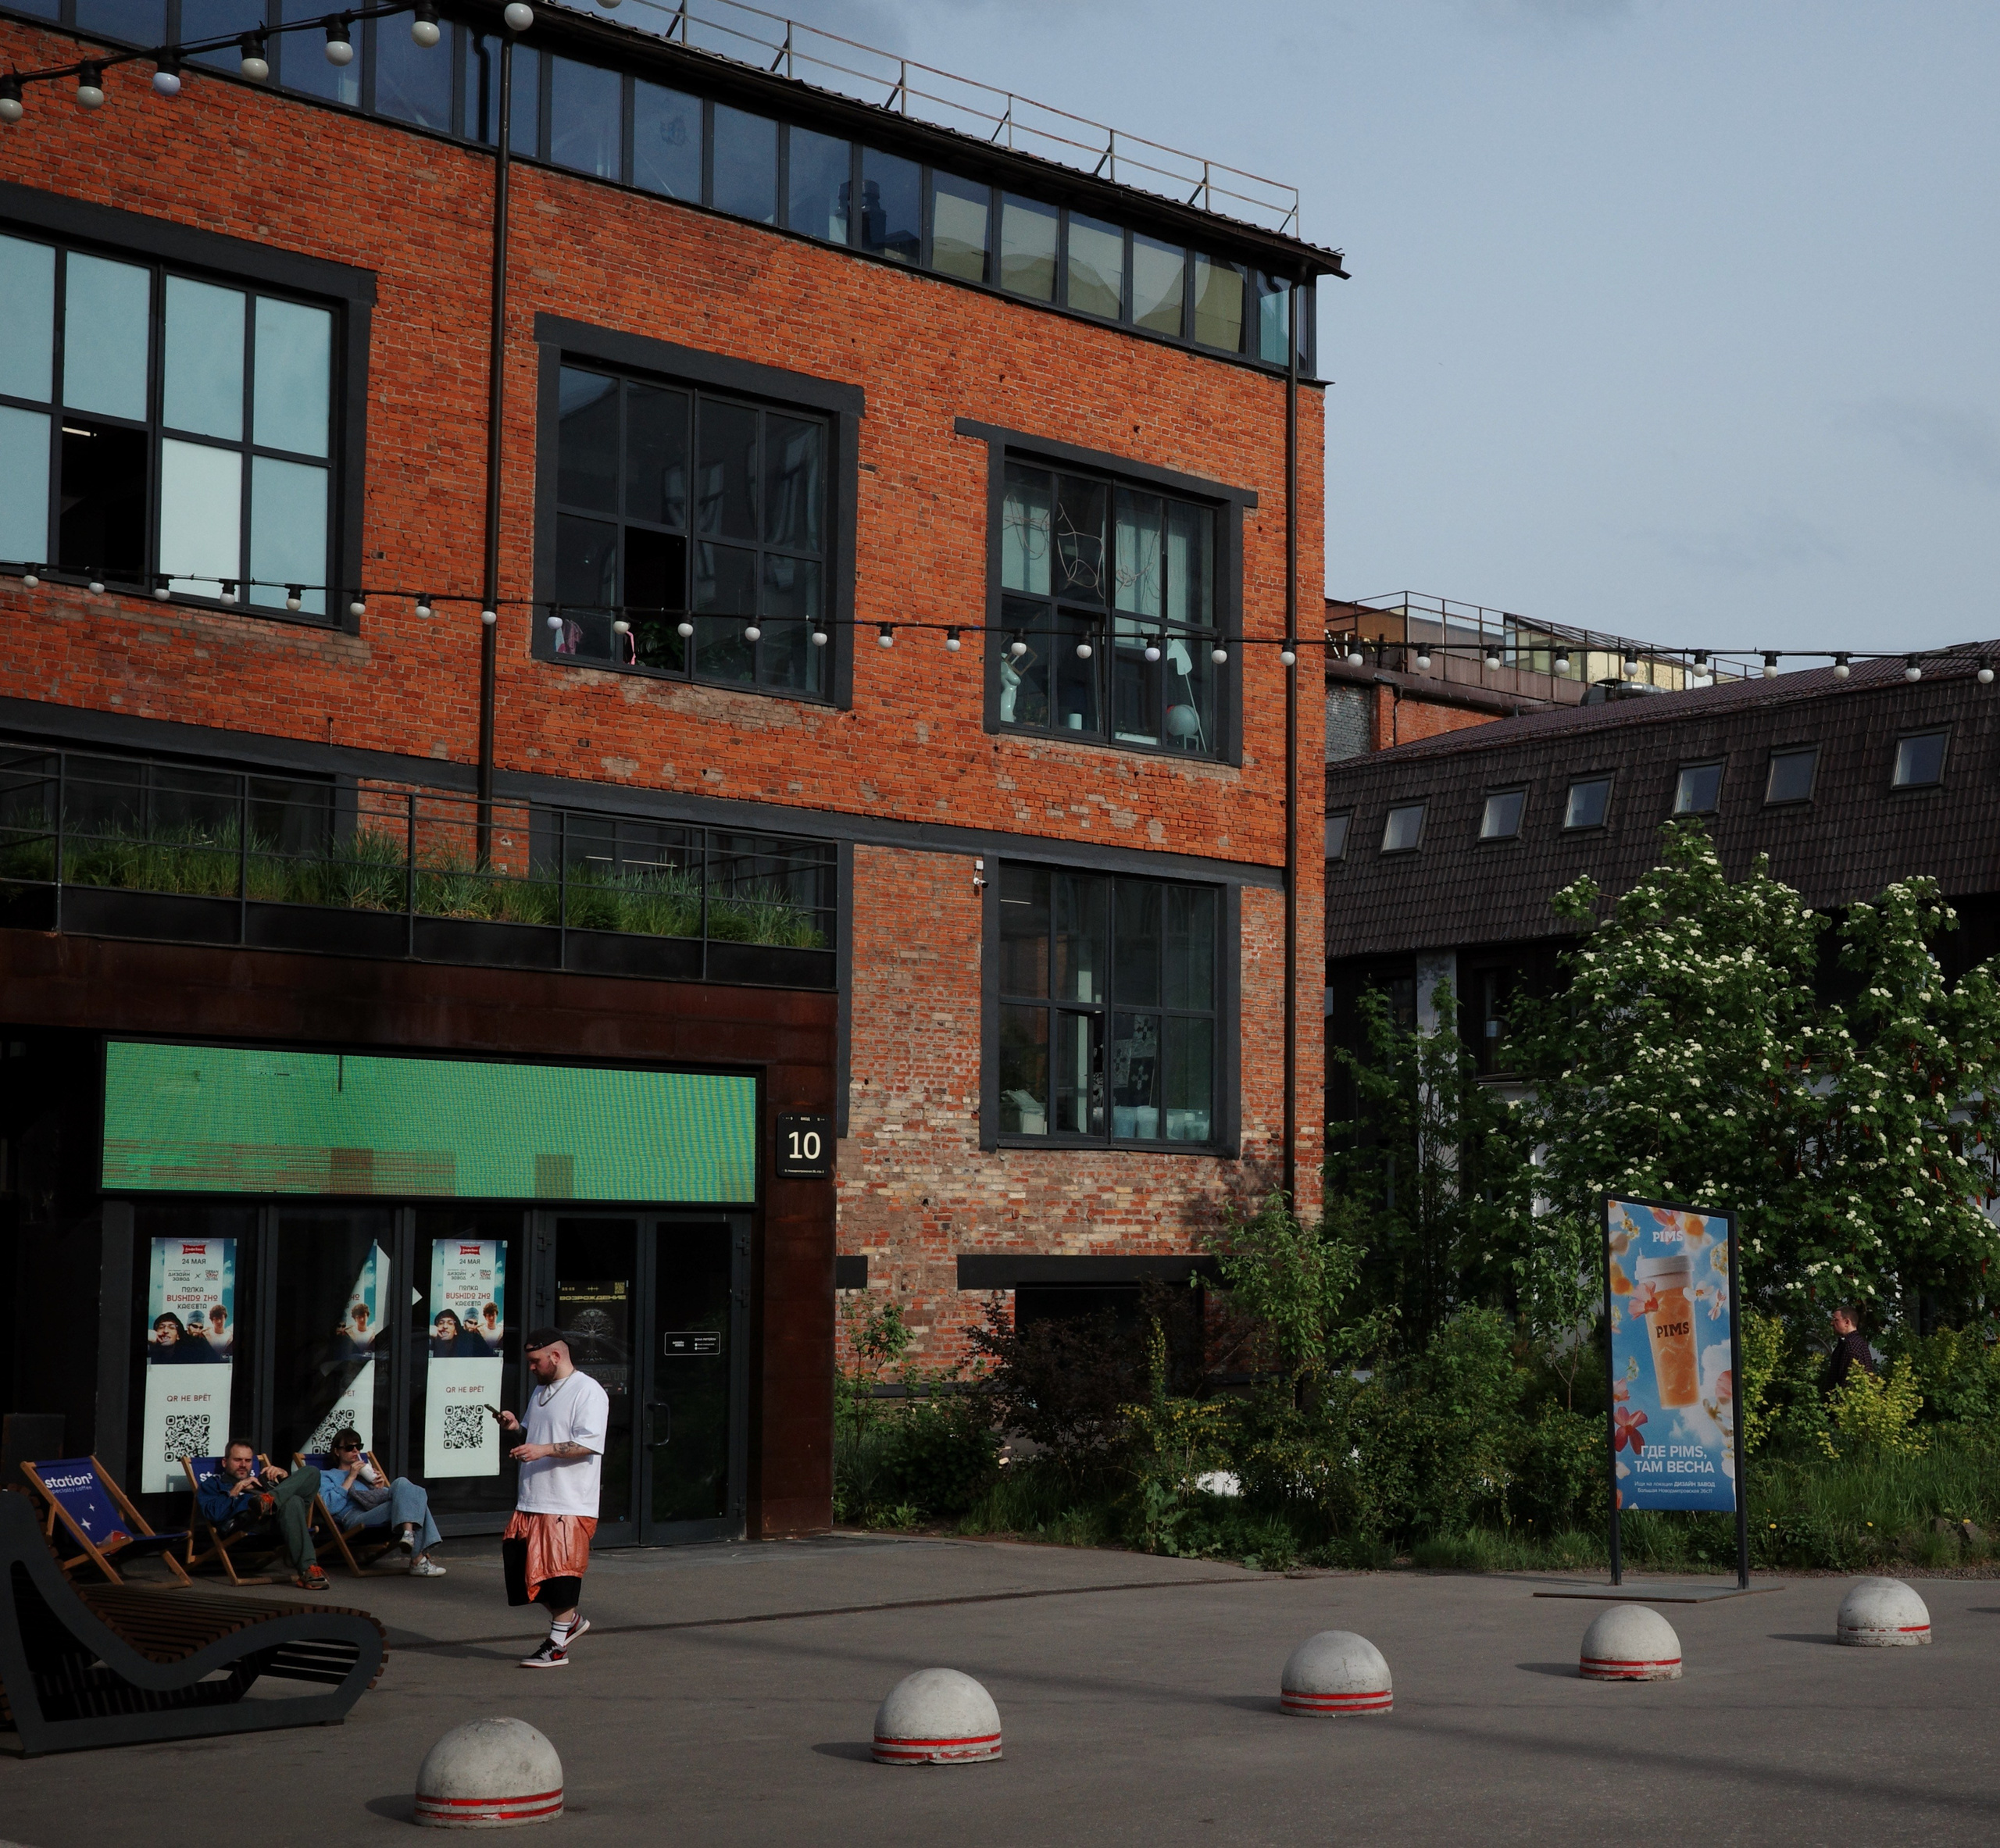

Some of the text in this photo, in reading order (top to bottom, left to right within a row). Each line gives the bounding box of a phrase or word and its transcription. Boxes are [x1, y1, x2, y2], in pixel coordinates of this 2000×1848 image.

[788, 1131, 821, 1160] 10
[1652, 1231, 1684, 1243] PIMS
[1655, 1322, 1690, 1339] PIMS
[1641, 1445, 1708, 1460] ГДЕ PIMS,
[1634, 1461, 1716, 1474] ТАМ ВЕСНА
